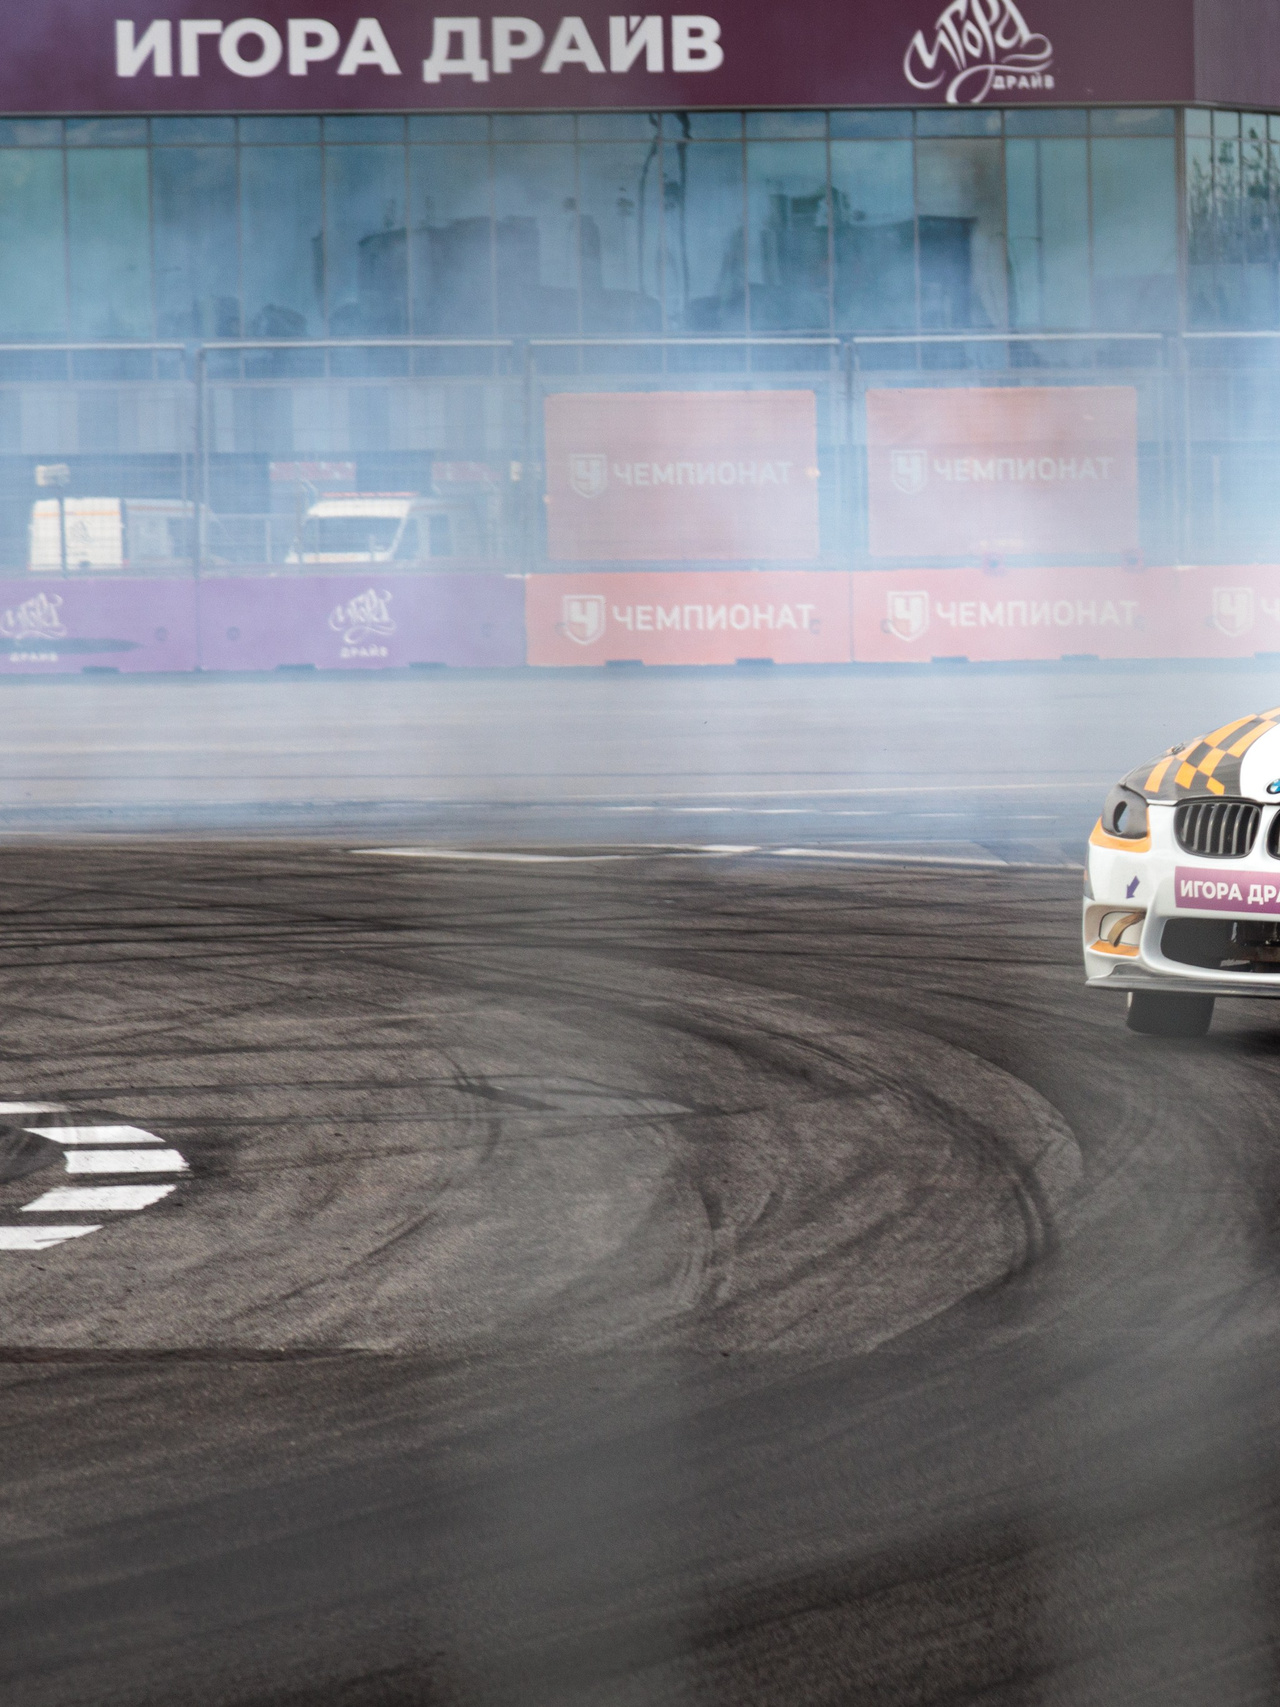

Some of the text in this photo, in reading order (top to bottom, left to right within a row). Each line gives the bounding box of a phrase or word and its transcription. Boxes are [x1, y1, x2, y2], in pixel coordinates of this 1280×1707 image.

[115, 14, 725, 83] ИГОРА ДРАЙВ
[992, 72, 1055, 90] ДРАЙВ
[613, 460, 796, 487] ЧЕМПИОНАТ
[933, 456, 1115, 484] ЧЕМПИОНАТ
[612, 602, 816, 632] ЧЕМПИОНАТ
[936, 600, 1138, 629] ЧЕМПИОНАТ
[1180, 879, 1242, 901] ИГОРА
